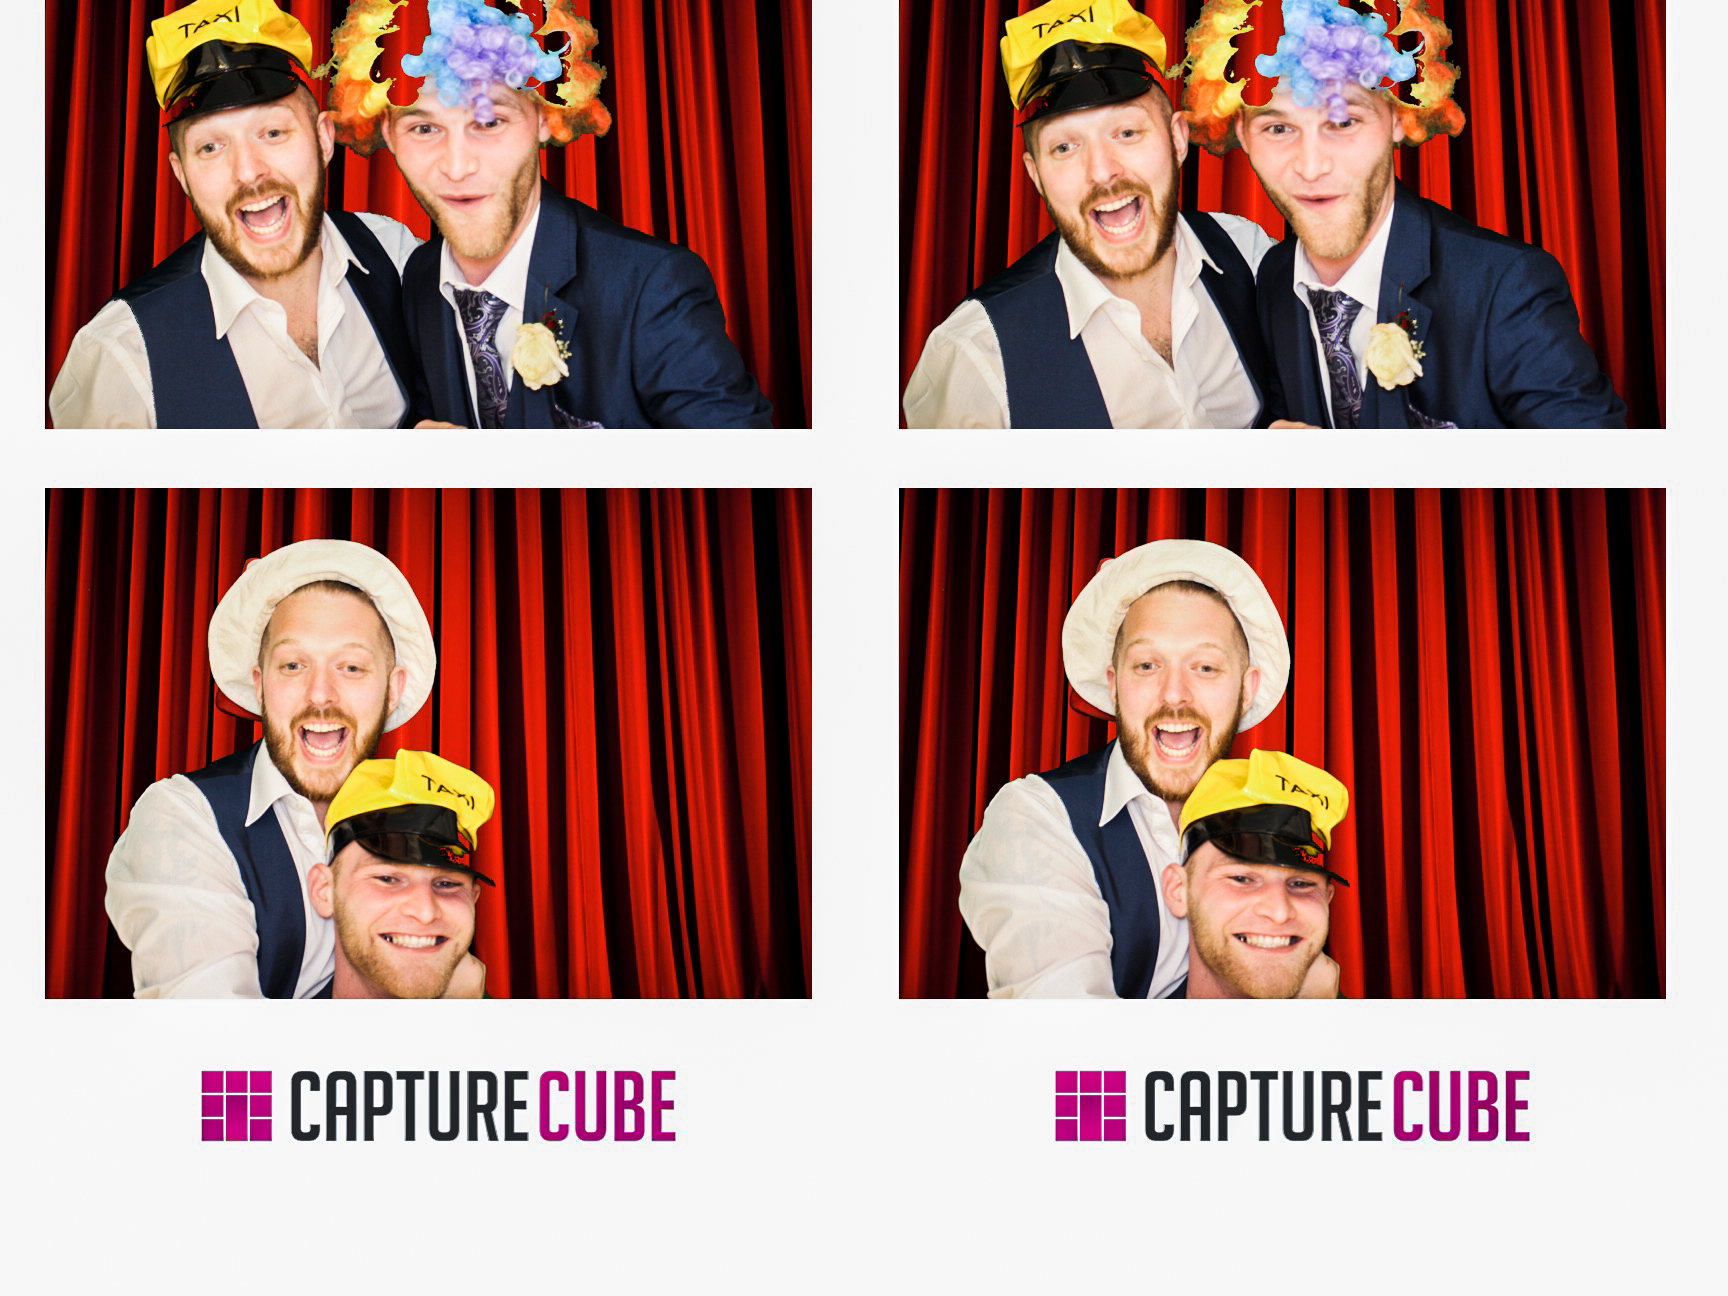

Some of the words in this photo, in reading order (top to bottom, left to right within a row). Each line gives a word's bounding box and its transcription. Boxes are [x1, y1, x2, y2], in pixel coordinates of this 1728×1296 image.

[178, 5, 240, 39] TAXI
[1032, 5, 1094, 39] TAXI
[421, 774, 475, 810] TAXI
[1275, 774, 1329, 810] TAXI
